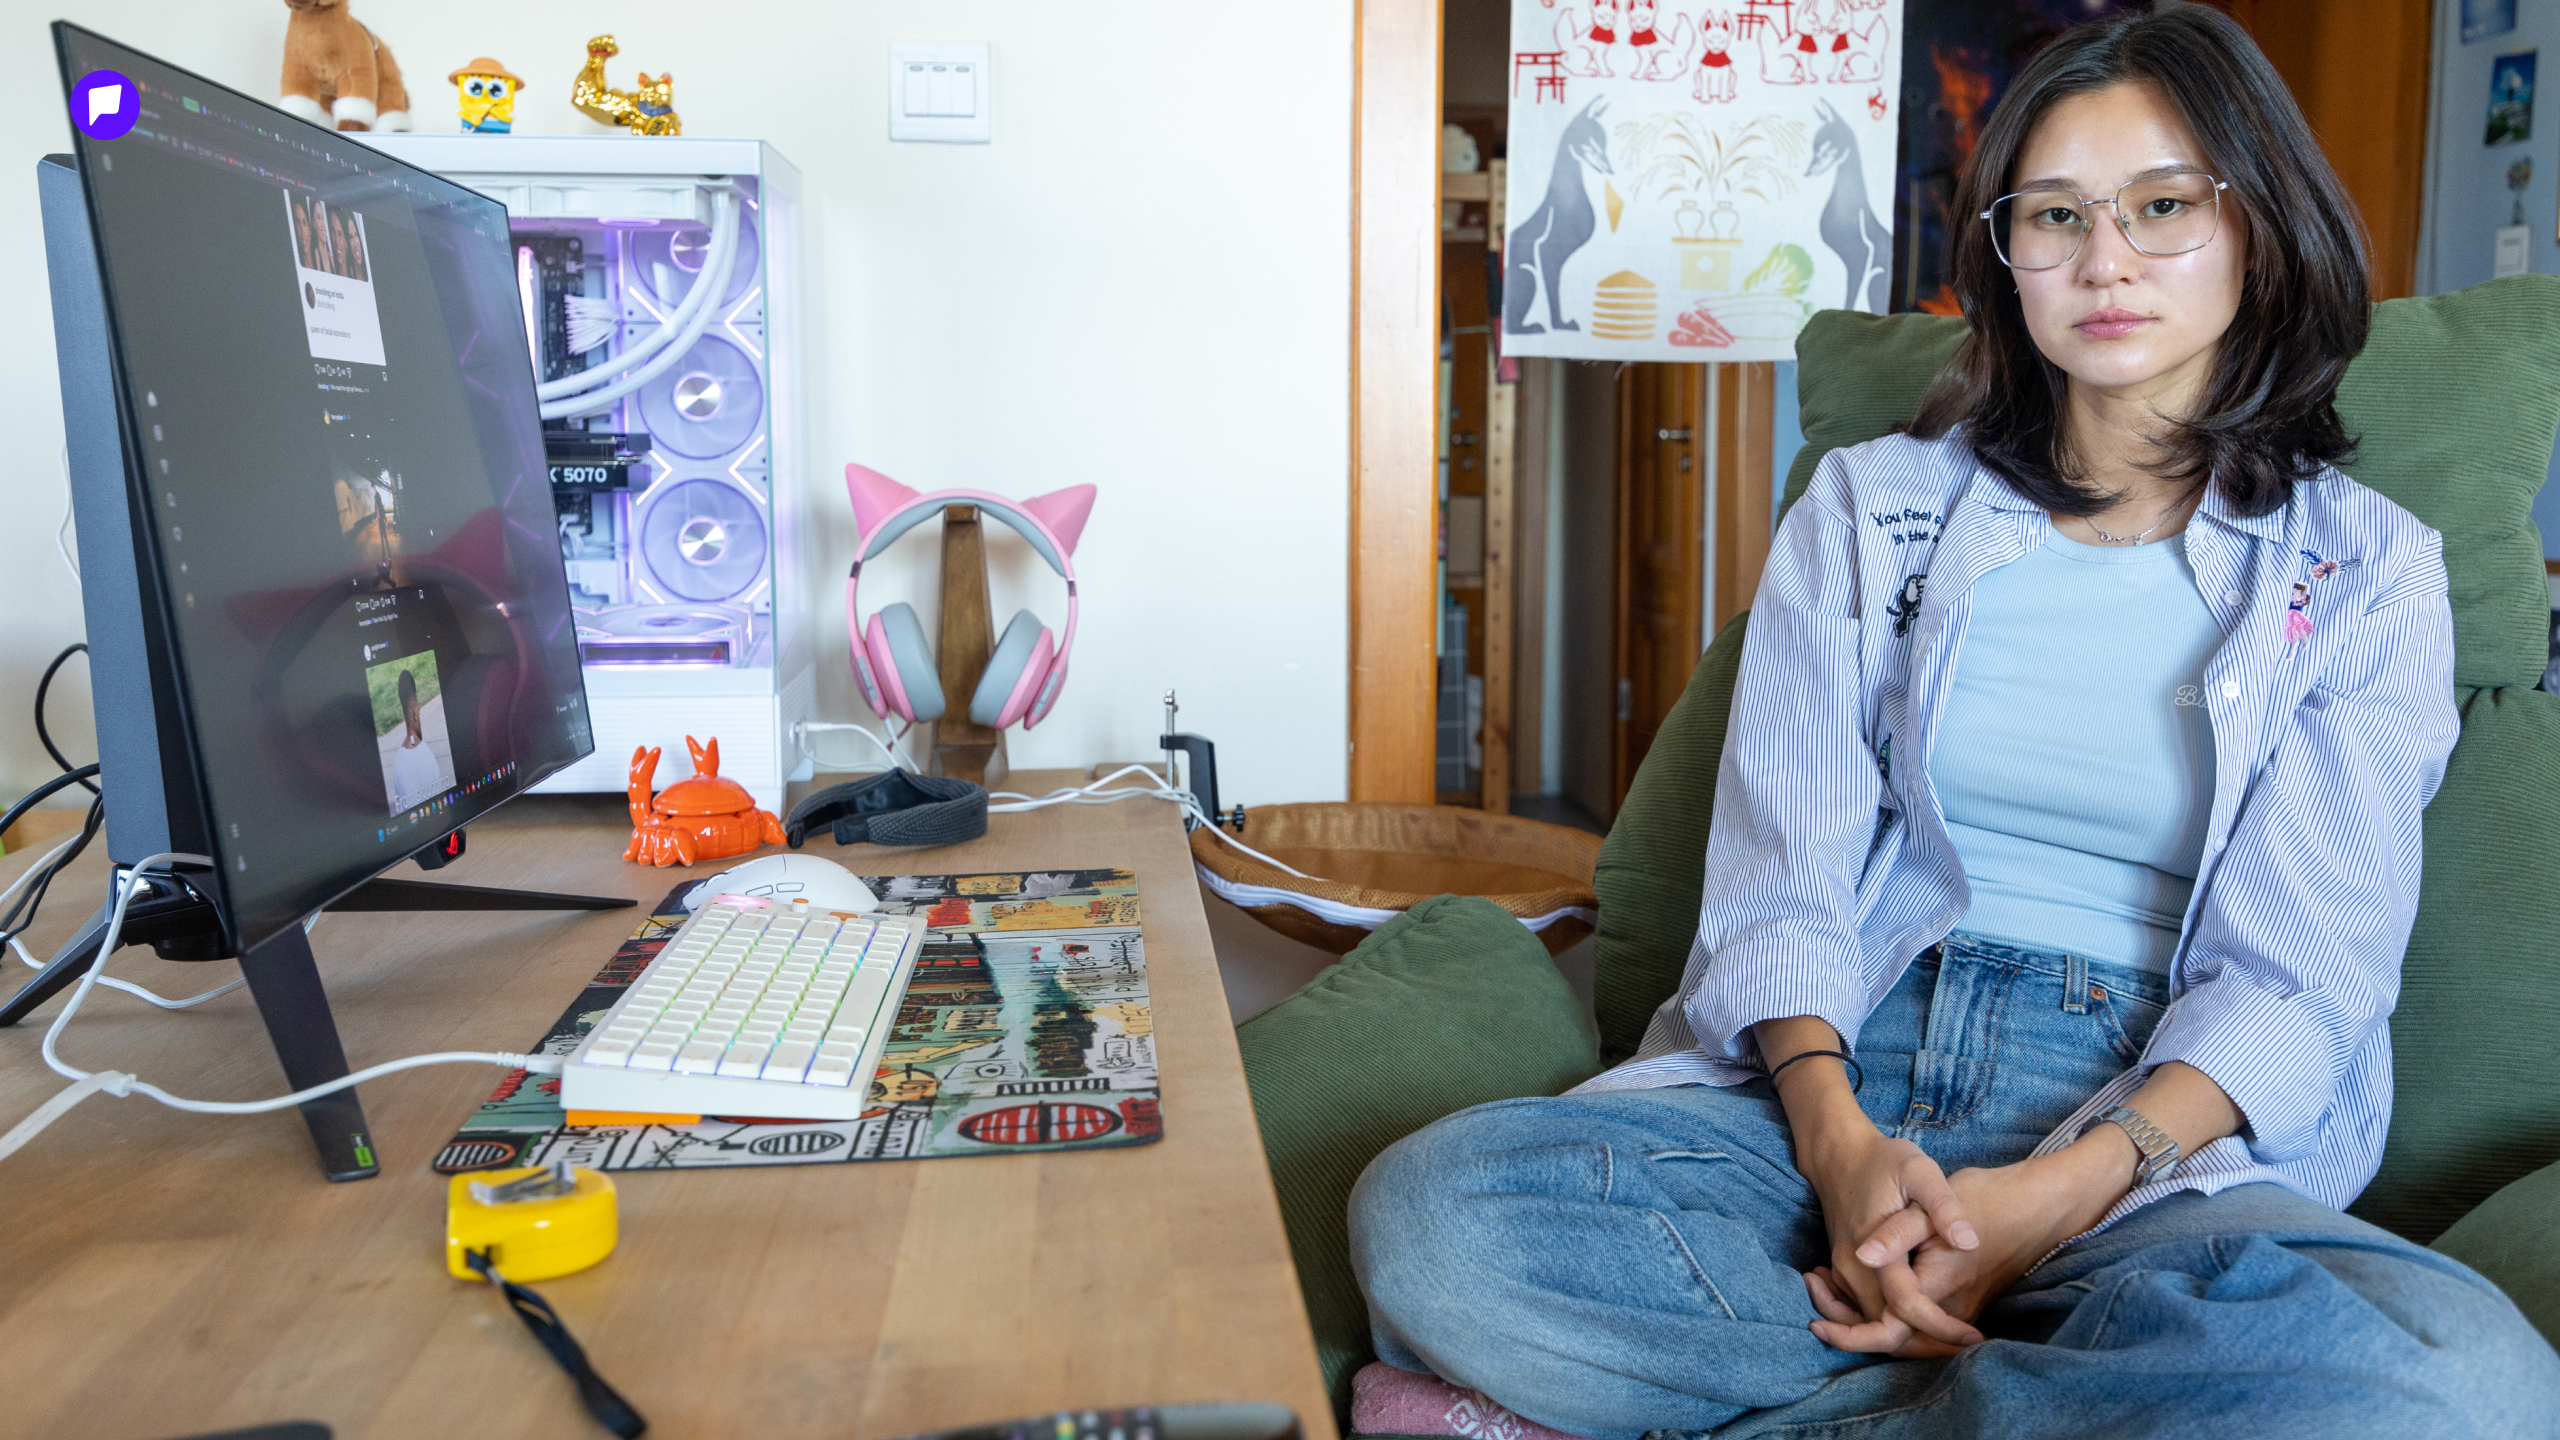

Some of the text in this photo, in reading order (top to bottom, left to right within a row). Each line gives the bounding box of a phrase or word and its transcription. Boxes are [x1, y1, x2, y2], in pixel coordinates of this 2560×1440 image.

[563, 467, 607, 483] 5070
[1870, 512, 1901, 527] You
[1908, 529, 1928, 542] the
